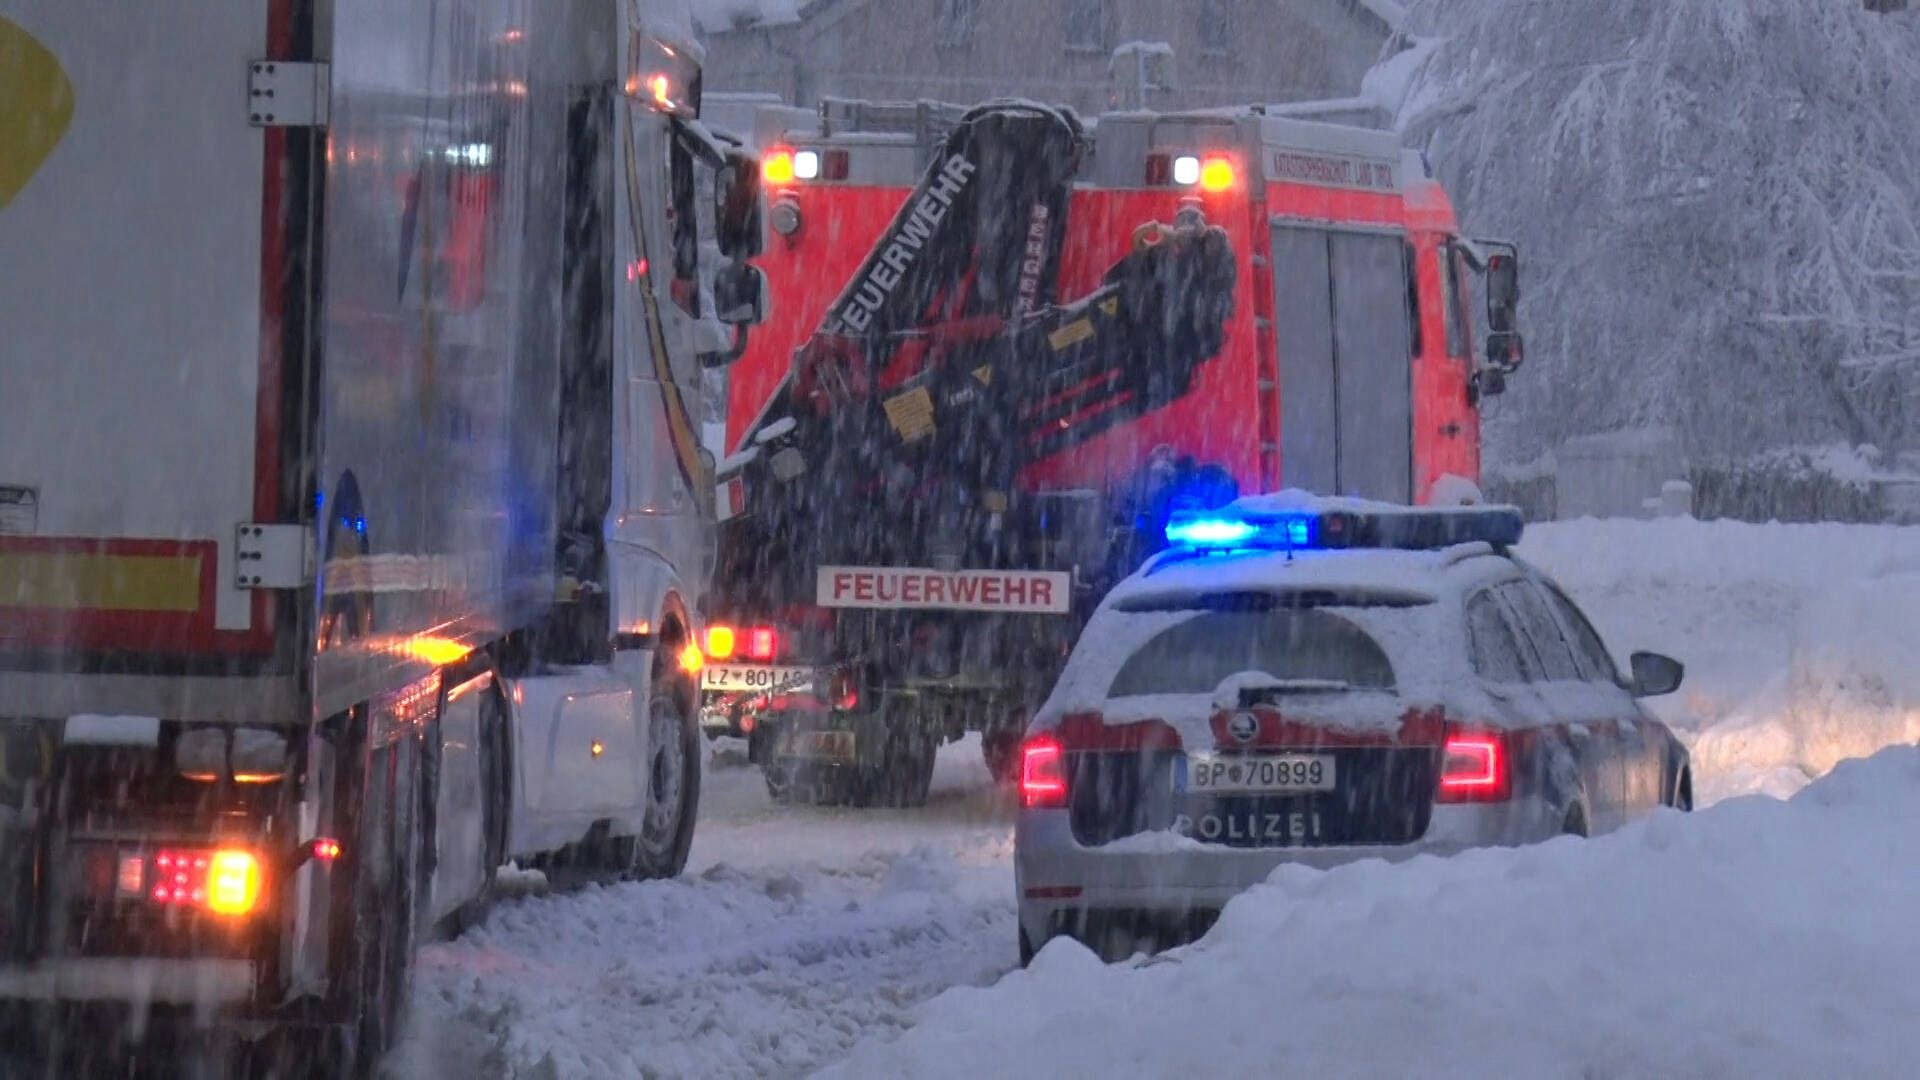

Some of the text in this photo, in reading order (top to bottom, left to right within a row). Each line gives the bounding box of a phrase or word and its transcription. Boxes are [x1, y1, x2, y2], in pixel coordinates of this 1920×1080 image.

[833, 573, 1053, 605] FEUERWEHR
[708, 669, 728, 685] LZ
[1195, 760, 1323, 786] BP 70899
[1173, 813, 1321, 839] POLIZEI
